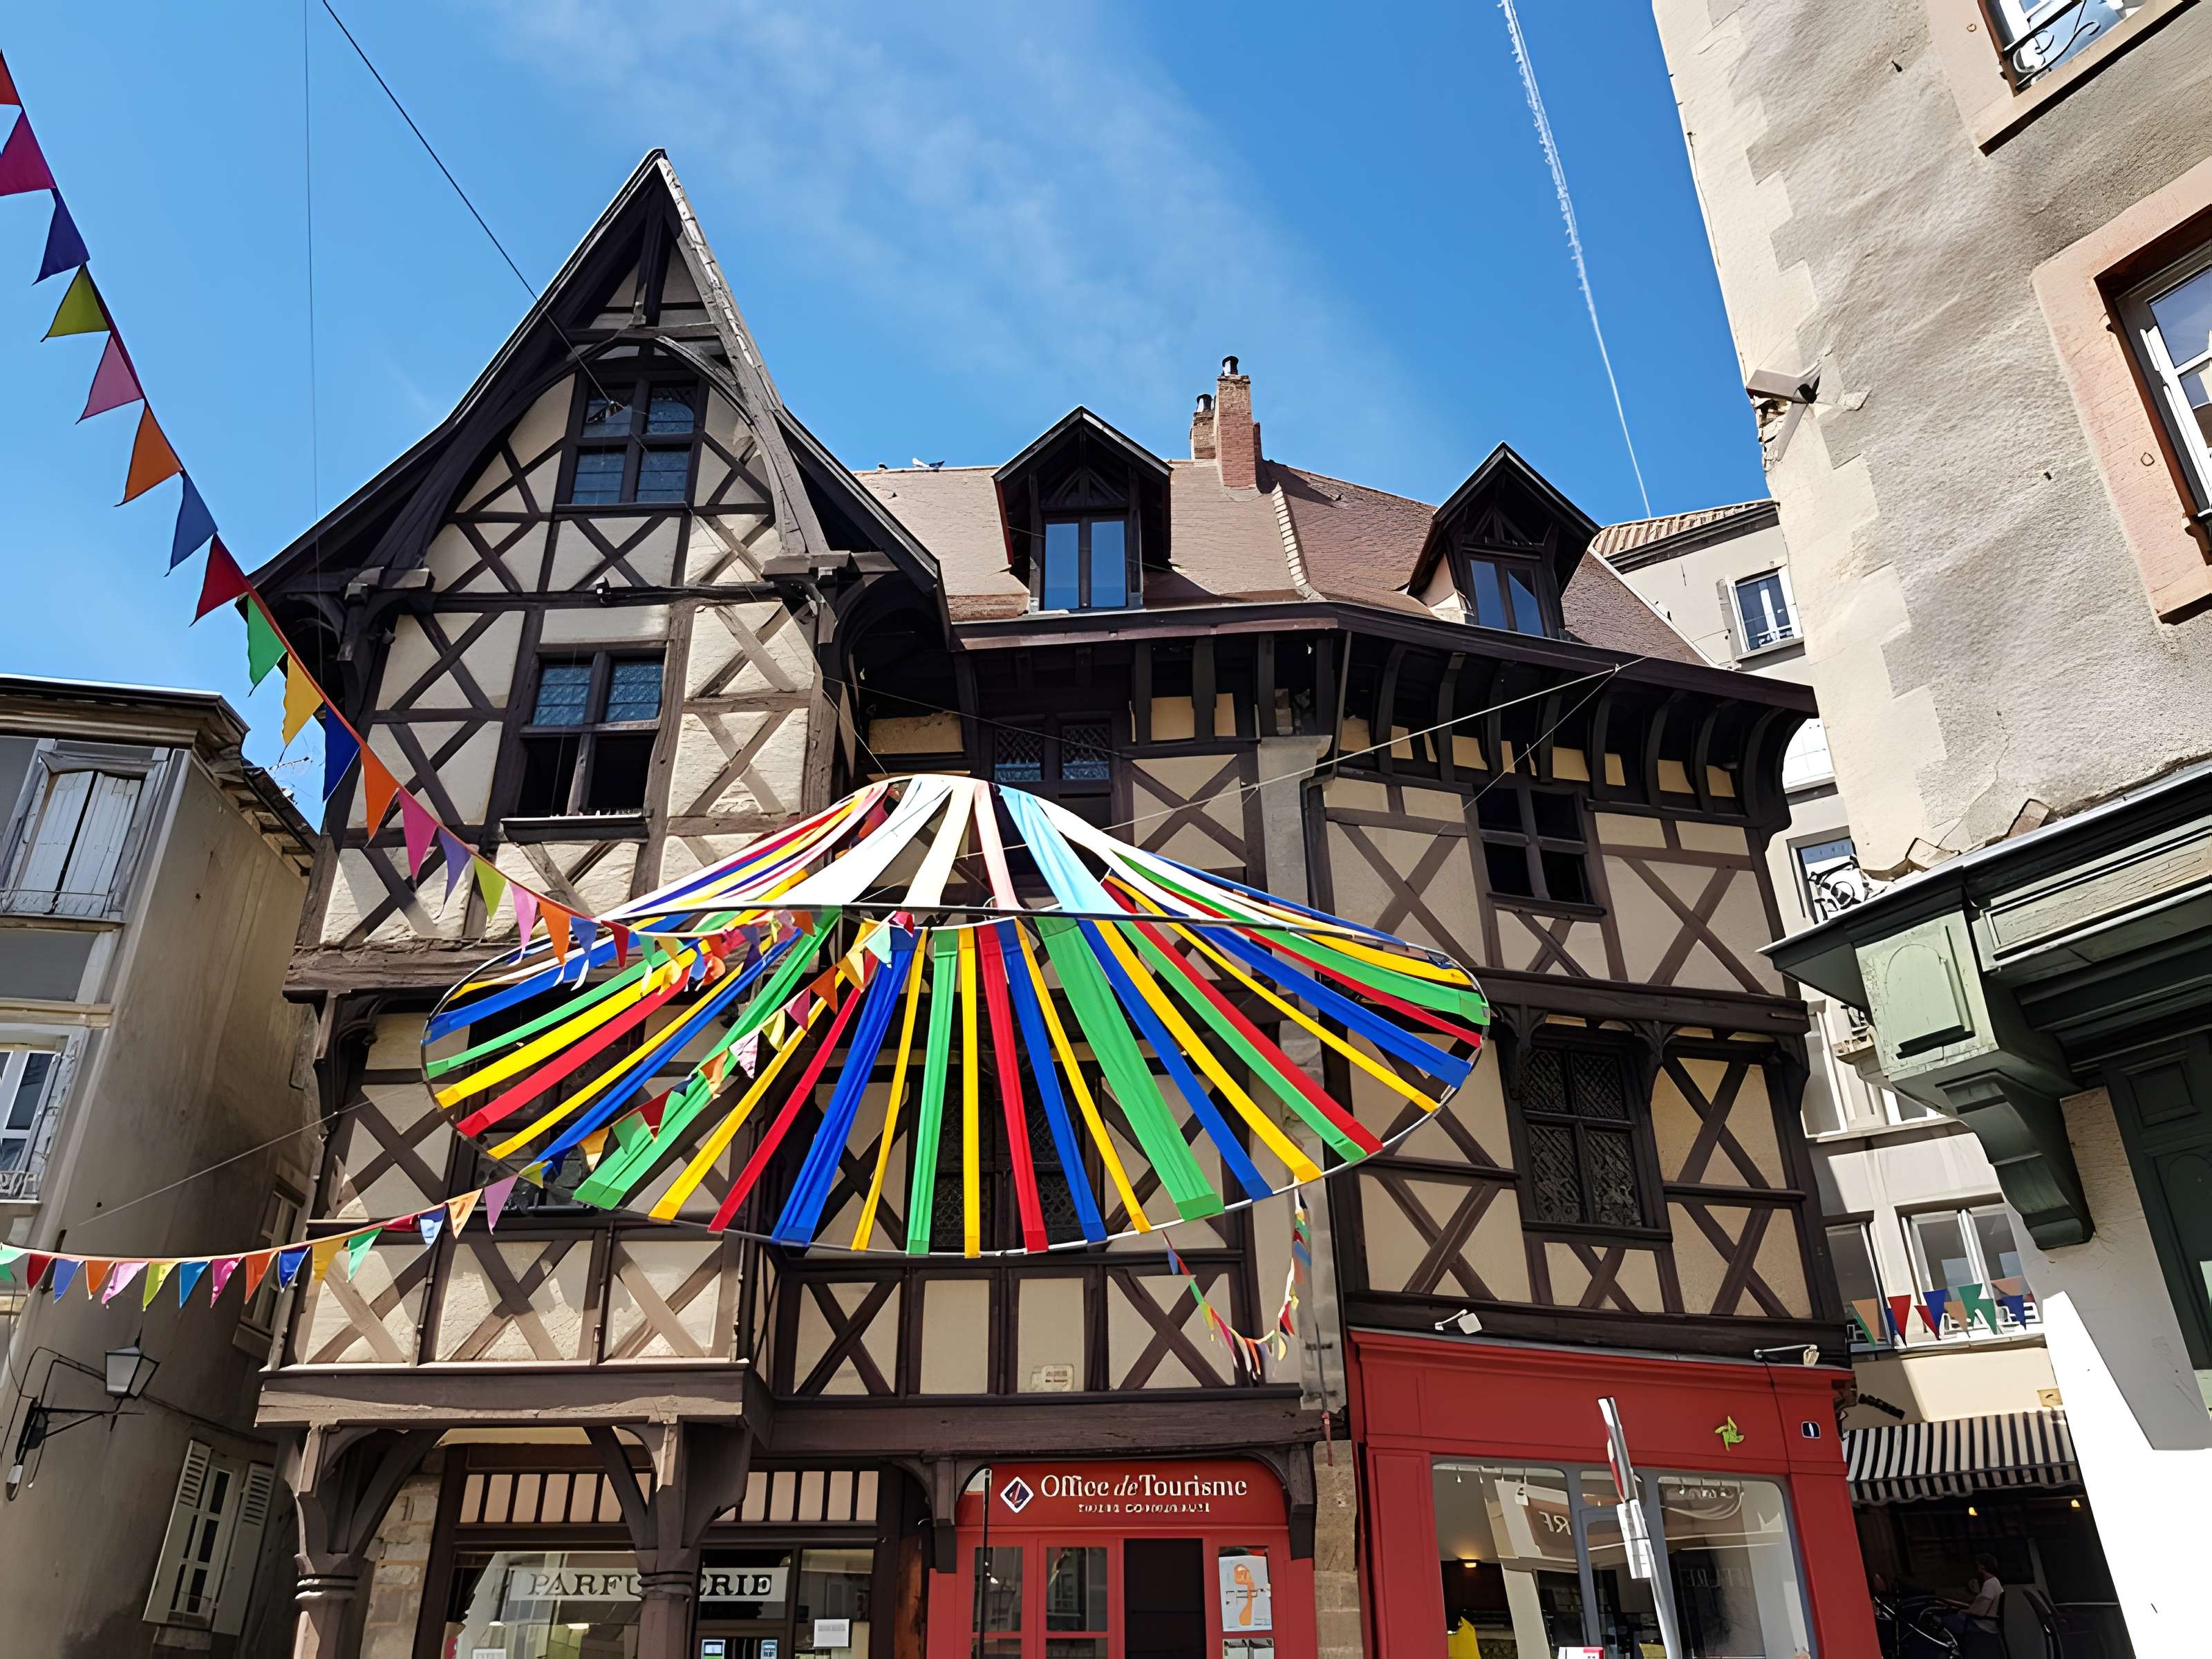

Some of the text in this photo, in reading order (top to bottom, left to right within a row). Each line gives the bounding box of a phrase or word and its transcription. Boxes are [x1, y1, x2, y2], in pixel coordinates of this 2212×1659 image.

[1041, 1474, 1247, 1497] Office de Tourisme
